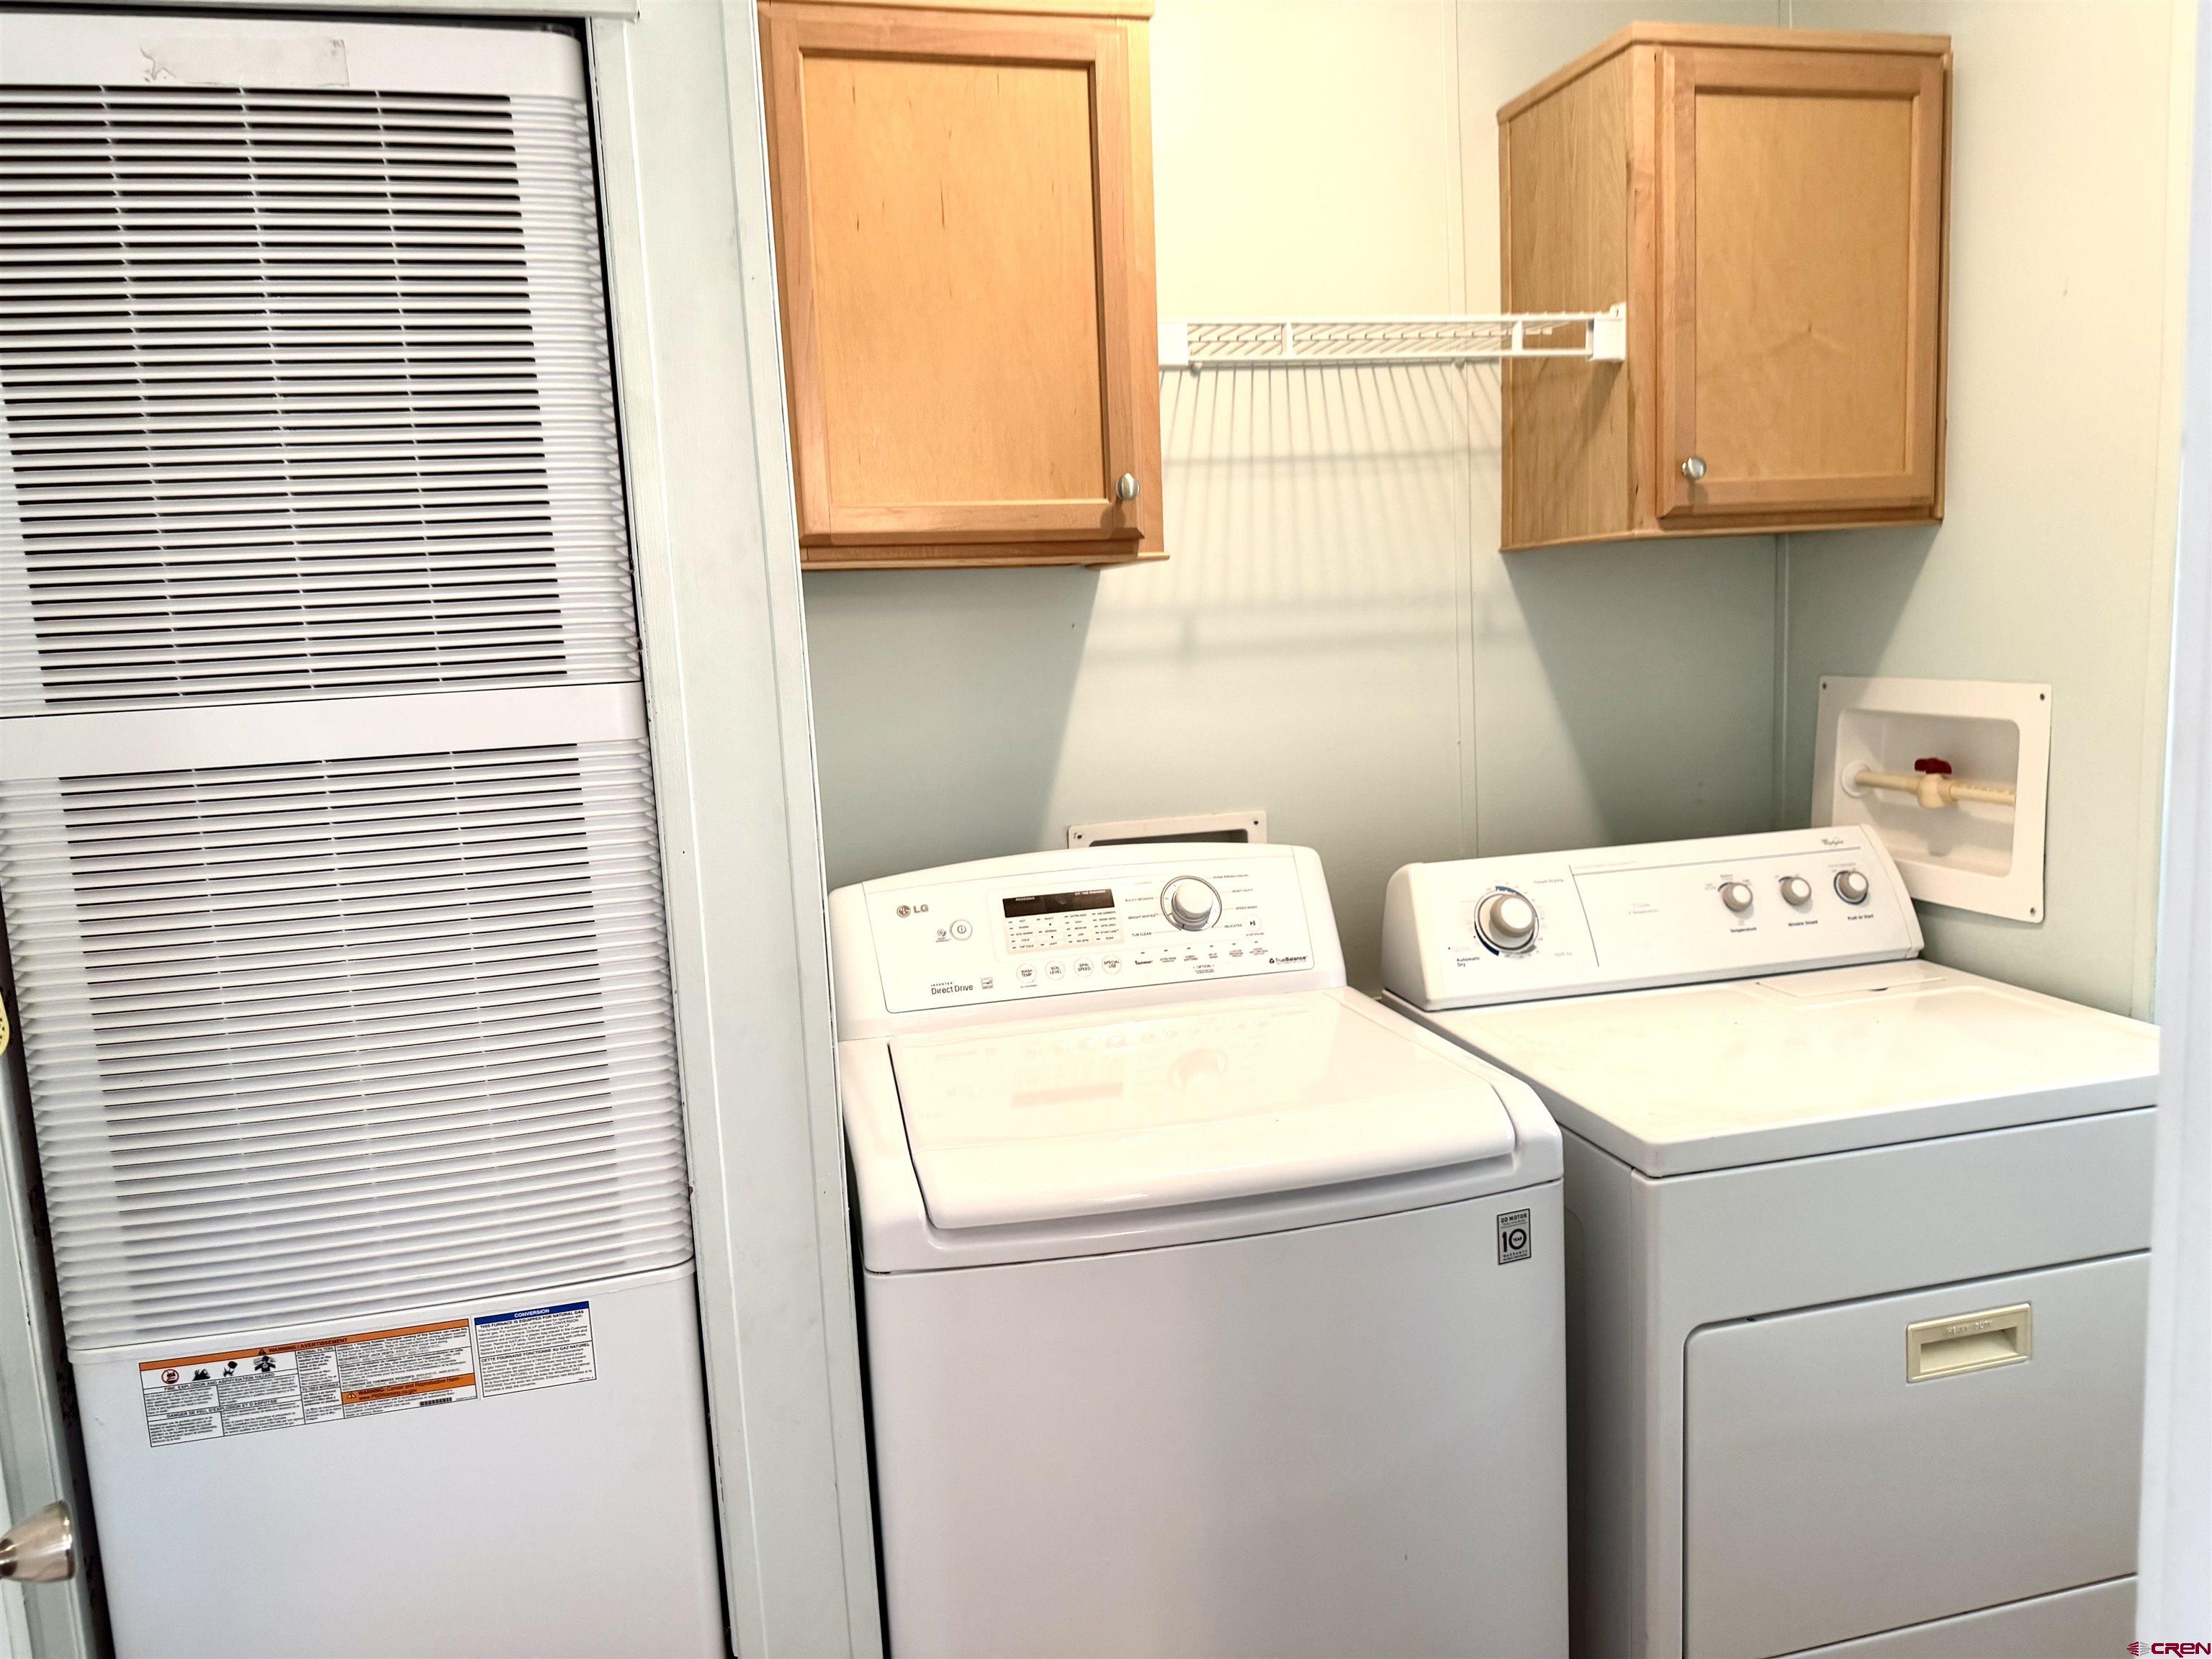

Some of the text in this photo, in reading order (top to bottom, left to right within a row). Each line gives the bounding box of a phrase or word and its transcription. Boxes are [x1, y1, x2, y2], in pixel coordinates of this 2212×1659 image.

[913, 904, 929, 914] LG
[931, 986, 953, 994] Direct
[1502, 1228, 1527, 1252] 10
[513, 1308, 550, 1318] CONVERSION
[301, 1338, 348, 1348] AVERTISSEMENT
[178, 1382, 207, 1390] EXPLOSION
[166, 1411, 189, 1420] DANGER
